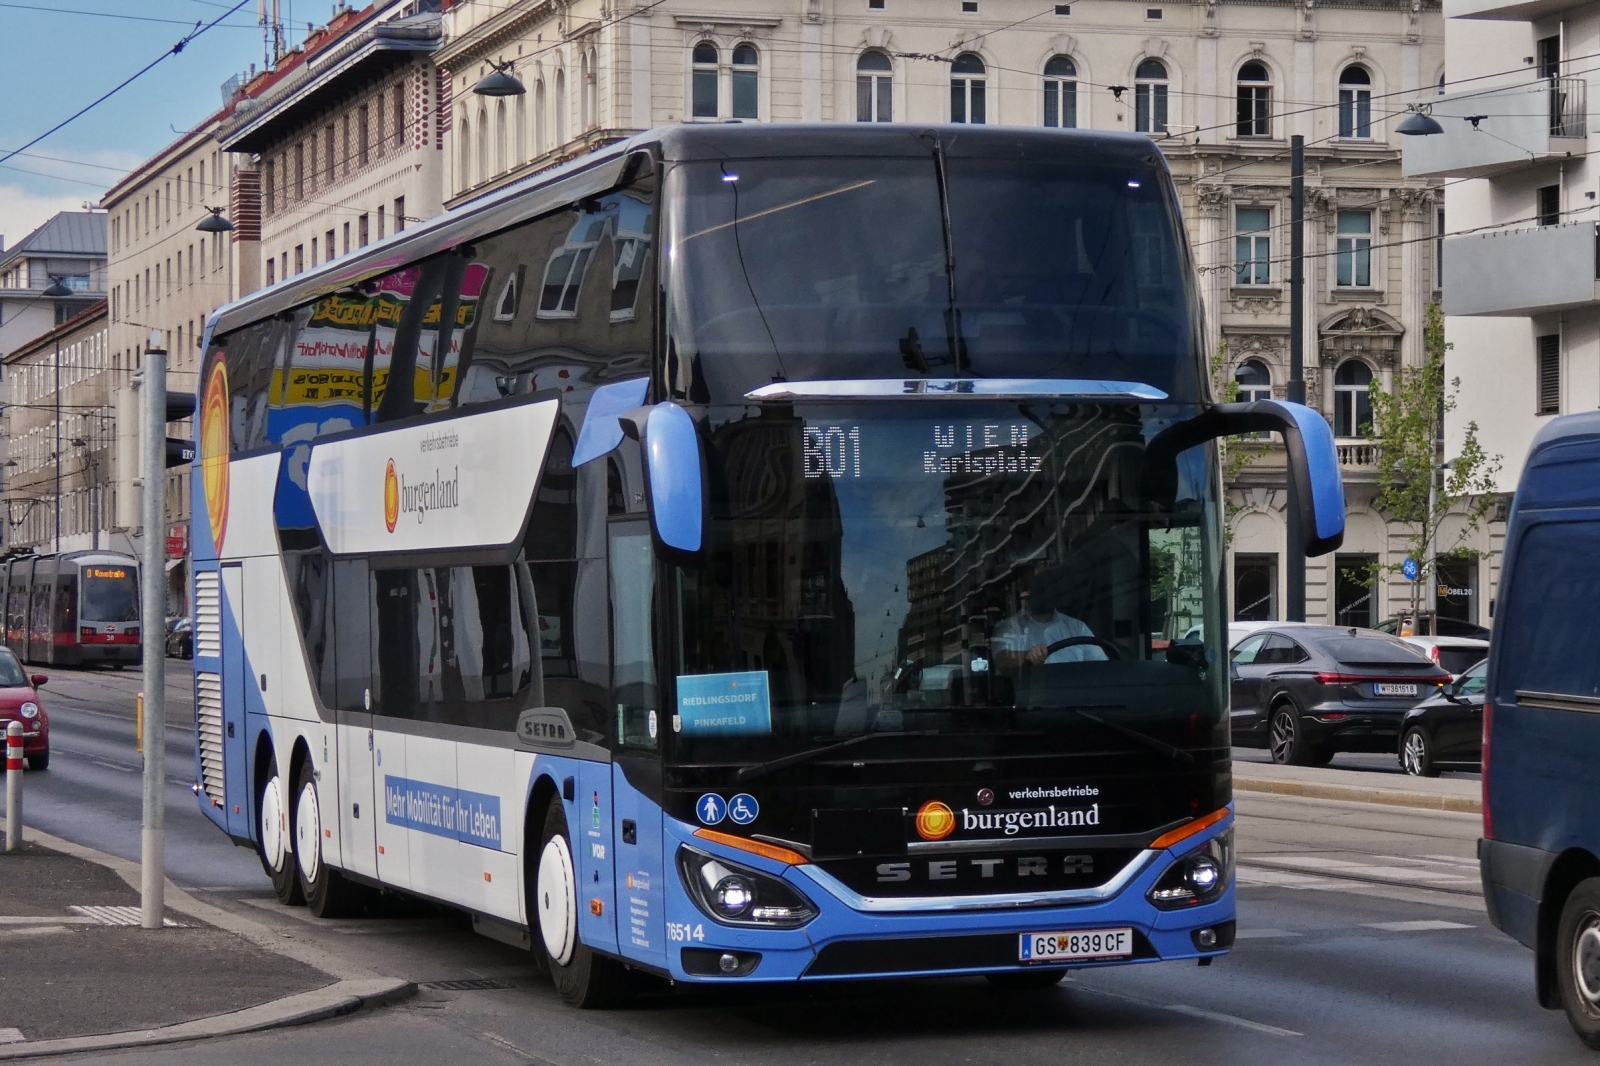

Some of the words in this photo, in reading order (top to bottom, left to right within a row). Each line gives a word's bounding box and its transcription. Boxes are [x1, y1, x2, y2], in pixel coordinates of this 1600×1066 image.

[420, 428, 459, 452] verkehrsbetriebe
[934, 425, 1028, 447] WIEN
[803, 426, 860, 478] B01
[923, 450, 1042, 476] Karlsplatz
[401, 465, 459, 524] burgenland
[682, 693, 757, 706] RIEDLINGSDORF
[525, 721, 565, 739] SETRA
[694, 716, 746, 727] PINKAFELD
[1009, 785, 1100, 800] verkehrsbetriebe
[386, 786, 406, 819] Mehr
[406, 790, 442, 827] Mobilität
[442, 795, 455, 831] für
[455, 799, 469, 834] Ihr
[470, 803, 500, 841] Leben.
[962, 803, 1100, 835] burgenland
[876, 855, 1095, 882] SETRA
[666, 923, 705, 942] 76514
[1036, 937, 1057, 955] GS
